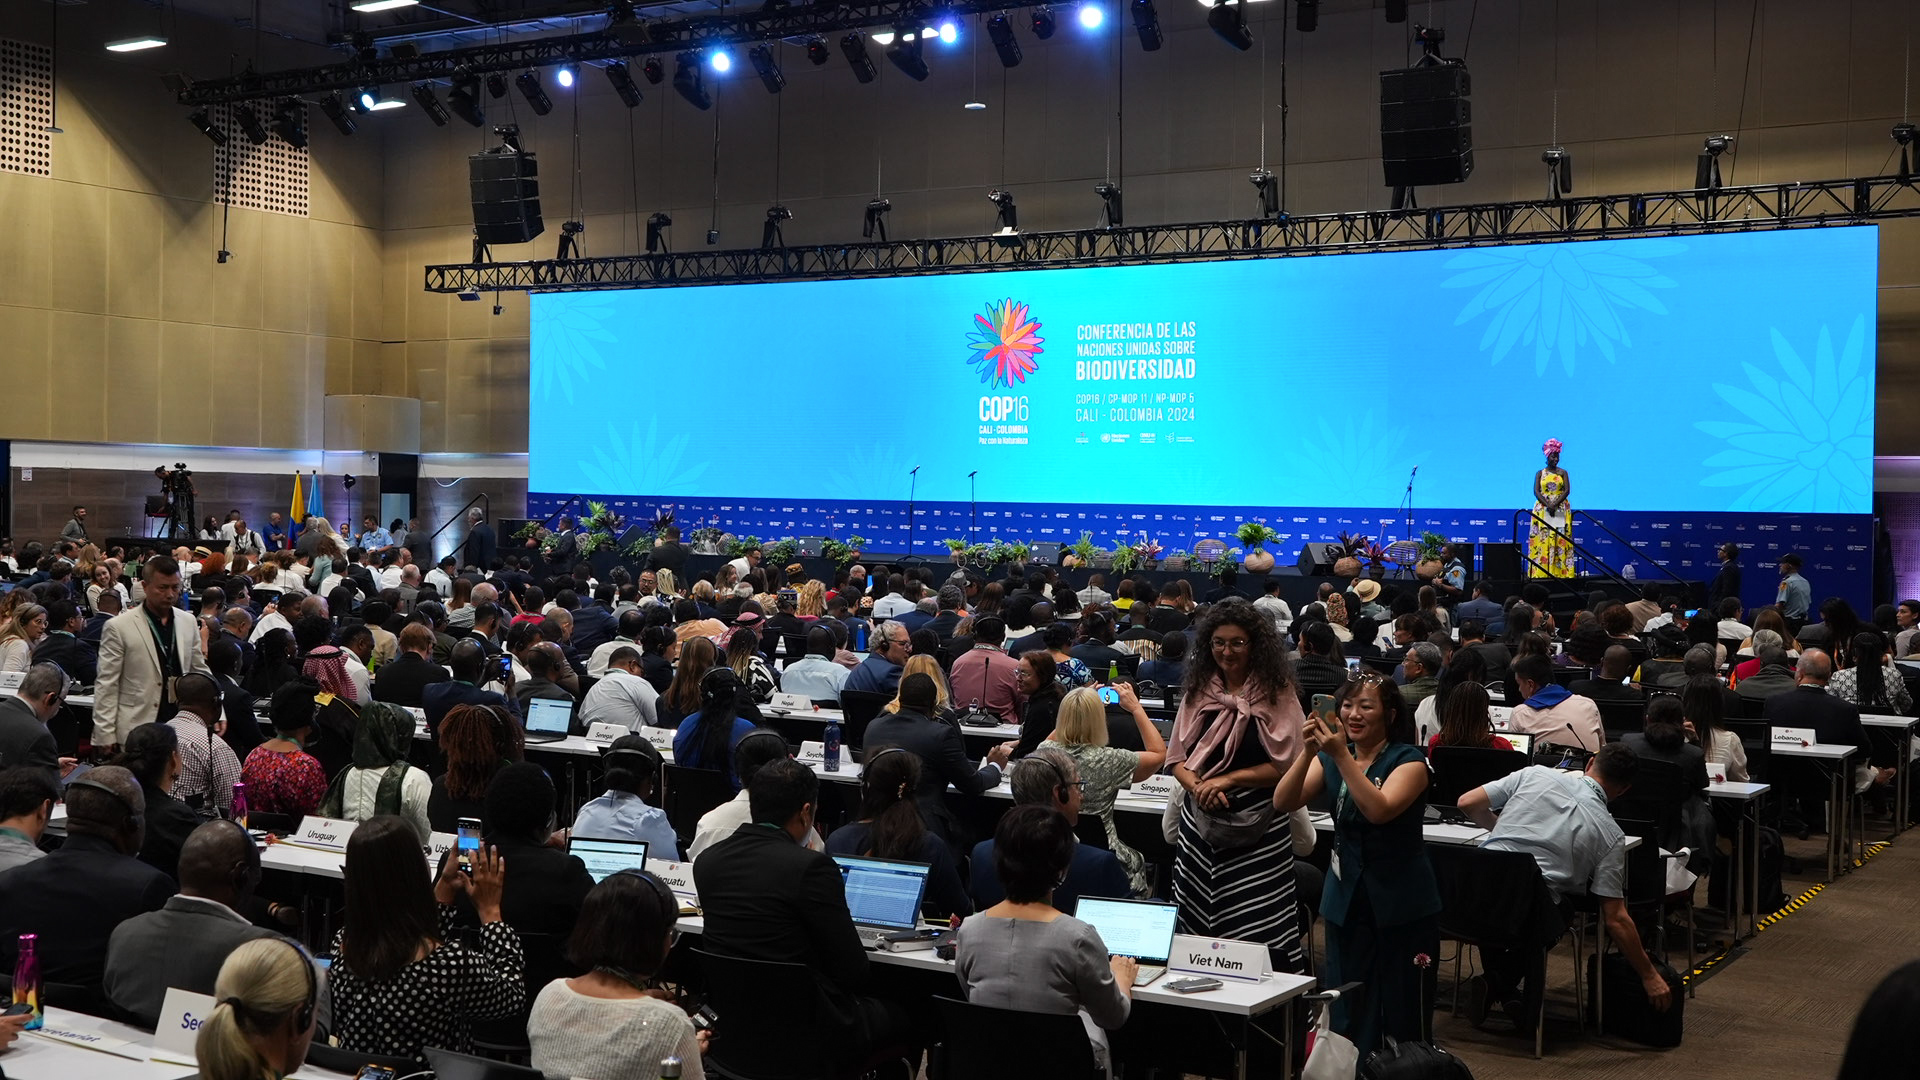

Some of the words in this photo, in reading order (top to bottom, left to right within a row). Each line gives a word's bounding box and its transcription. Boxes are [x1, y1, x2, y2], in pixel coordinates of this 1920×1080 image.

[1077, 323, 1154, 340] CONFERENCIA
[1156, 322, 1171, 338] DE
[1174, 321, 1196, 338] LAS
[1077, 342, 1124, 356] NACIONES
[1126, 341, 1161, 355] UNIDAS
[1163, 340, 1196, 354] SOBRE
[1076, 358, 1196, 380] BIODIVERSIDAD
[1075, 394, 1100, 404] COP16
[1189, 392, 1195, 403] 5
[979, 395, 1029, 421] COP16
[1075, 408, 1098, 422] CALI
[1110, 408, 1163, 422] COLOMBIA
[1167, 407, 1195, 422] 2024
[979, 425, 993, 434] CALI
[996, 425, 1029, 434] COLOMBIA
[595, 731, 614, 740] Senegal
[649, 736, 665, 744] Serbia
[1774, 734, 1802, 742] Lebanon
[1140, 783, 1170, 793] Singapor
[307, 830, 338, 842] Uruguay
[1189, 953, 1212, 967] Viet
[1215, 957, 1243, 971] Nam
